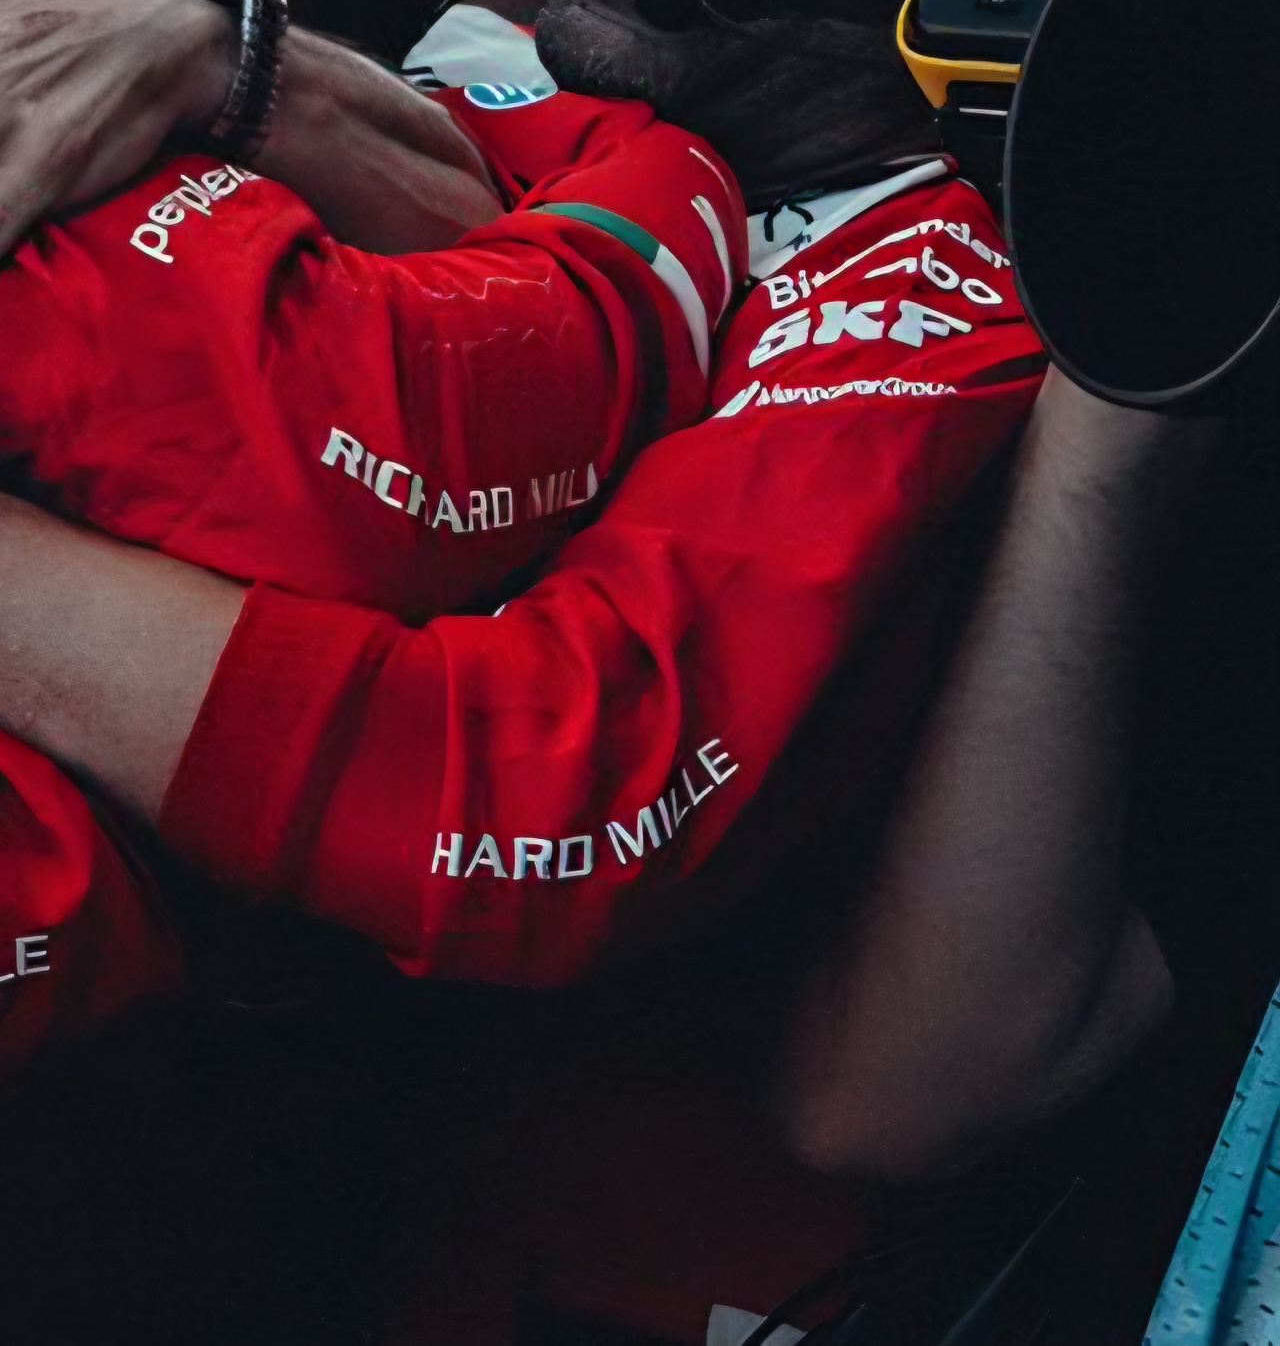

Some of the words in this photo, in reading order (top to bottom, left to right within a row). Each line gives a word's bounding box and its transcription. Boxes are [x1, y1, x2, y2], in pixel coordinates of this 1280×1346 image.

[748, 299, 973, 369] SKF
[430, 832, 594, 881] HARD
[605, 737, 740, 866] MILLE
